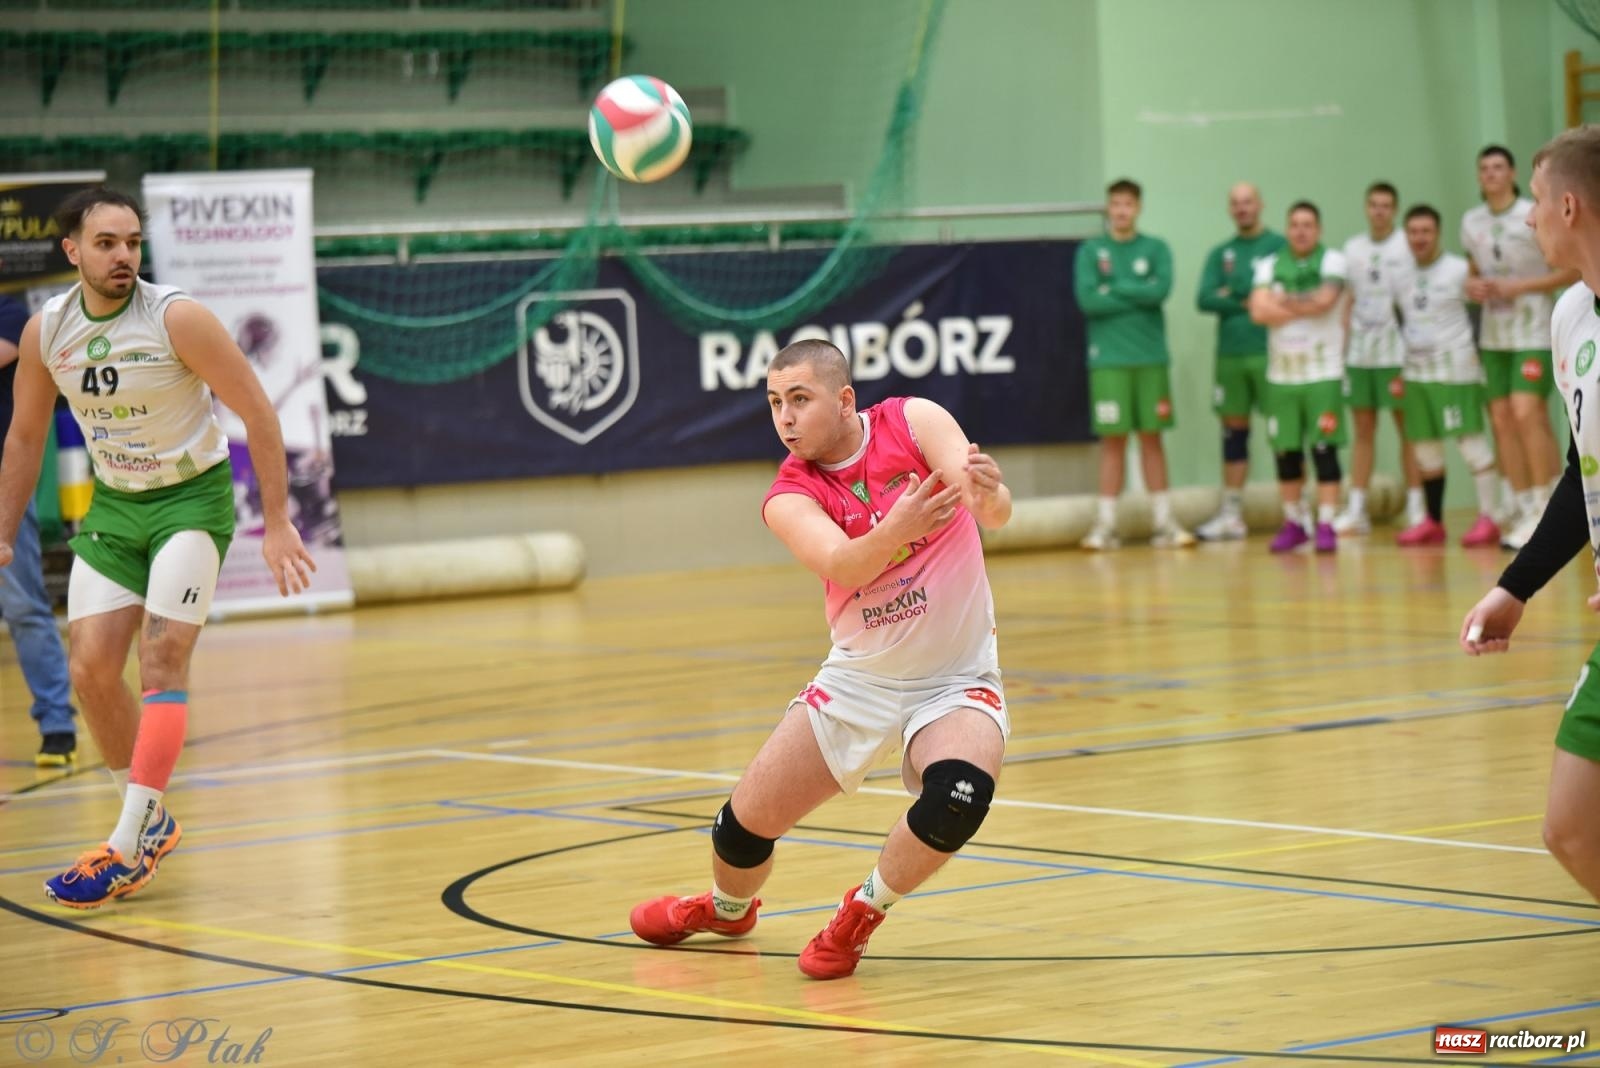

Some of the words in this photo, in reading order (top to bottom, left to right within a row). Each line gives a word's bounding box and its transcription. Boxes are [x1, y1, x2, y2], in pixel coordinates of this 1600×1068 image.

[170, 193, 294, 222] PIVEXIN
[174, 225, 294, 243] TECHNOLOGY
[700, 304, 1015, 391] RAIBÓRZ
[81, 365, 119, 397] 49
[80, 404, 148, 420] VISON
